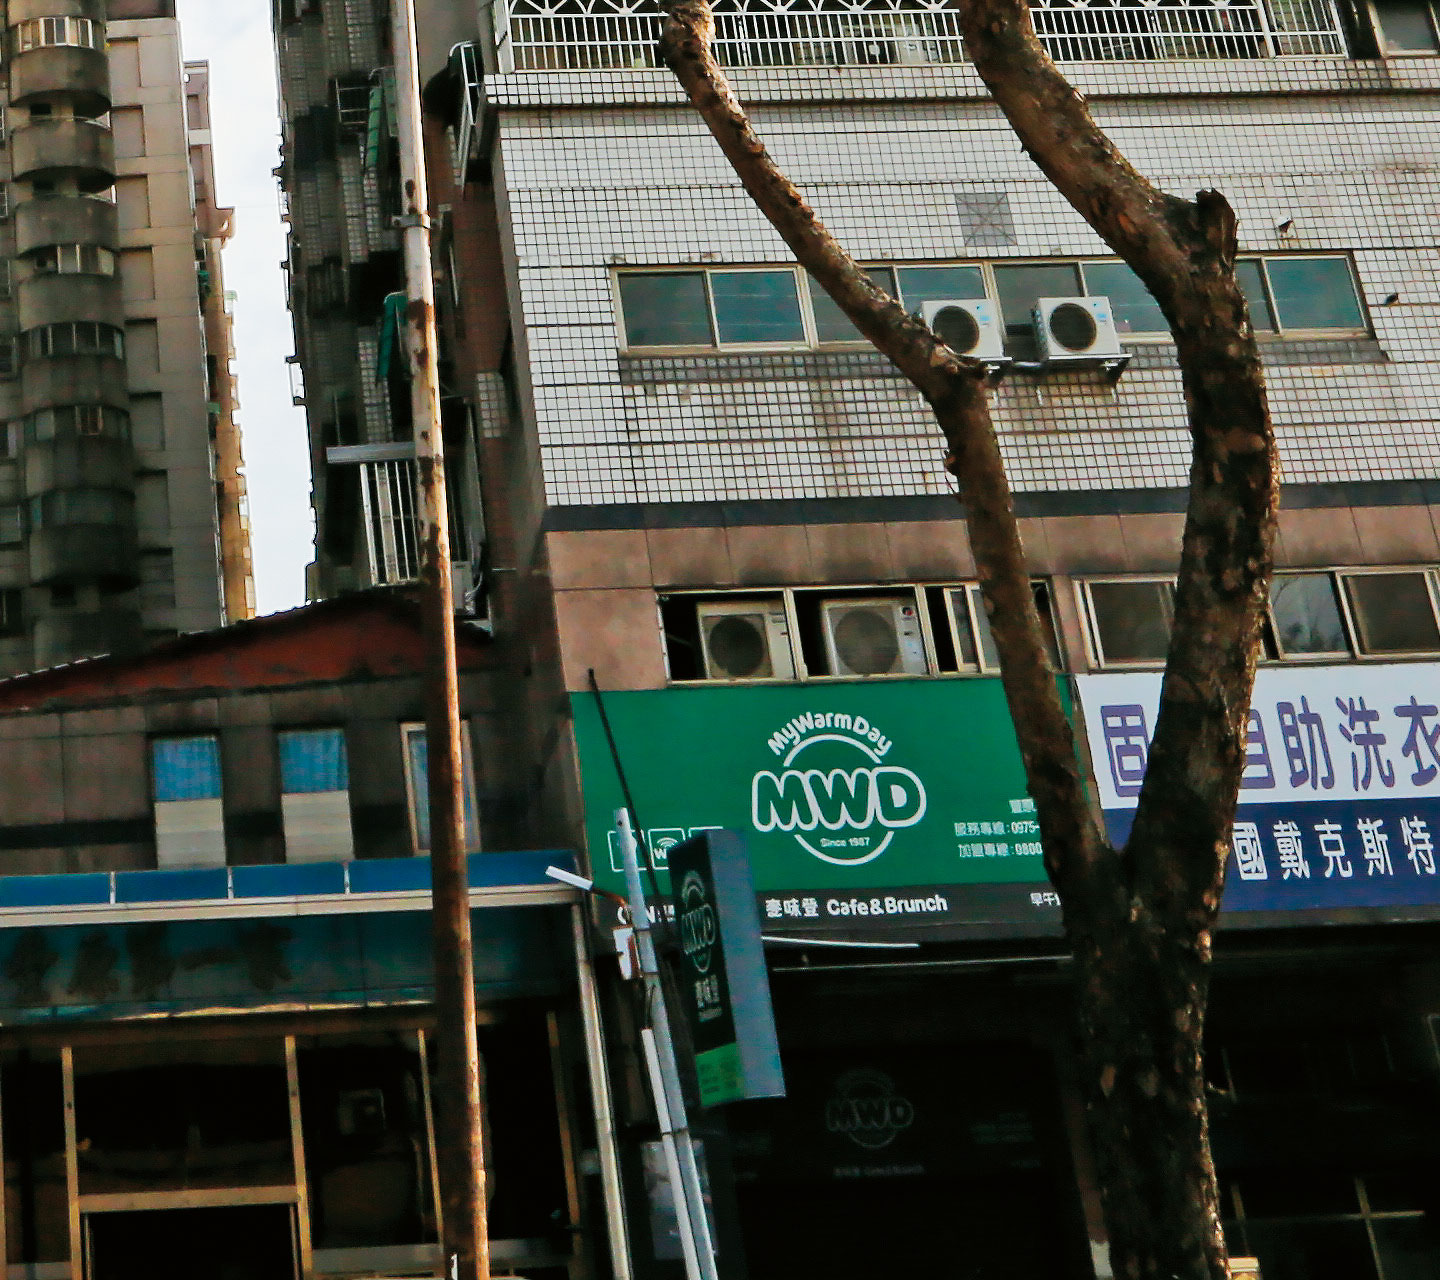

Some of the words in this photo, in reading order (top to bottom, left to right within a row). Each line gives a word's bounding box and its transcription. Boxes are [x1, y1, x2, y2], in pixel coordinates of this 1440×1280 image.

[751, 766, 927, 833] MWD
[1232, 814, 1437, 881] 國戴克斯特
